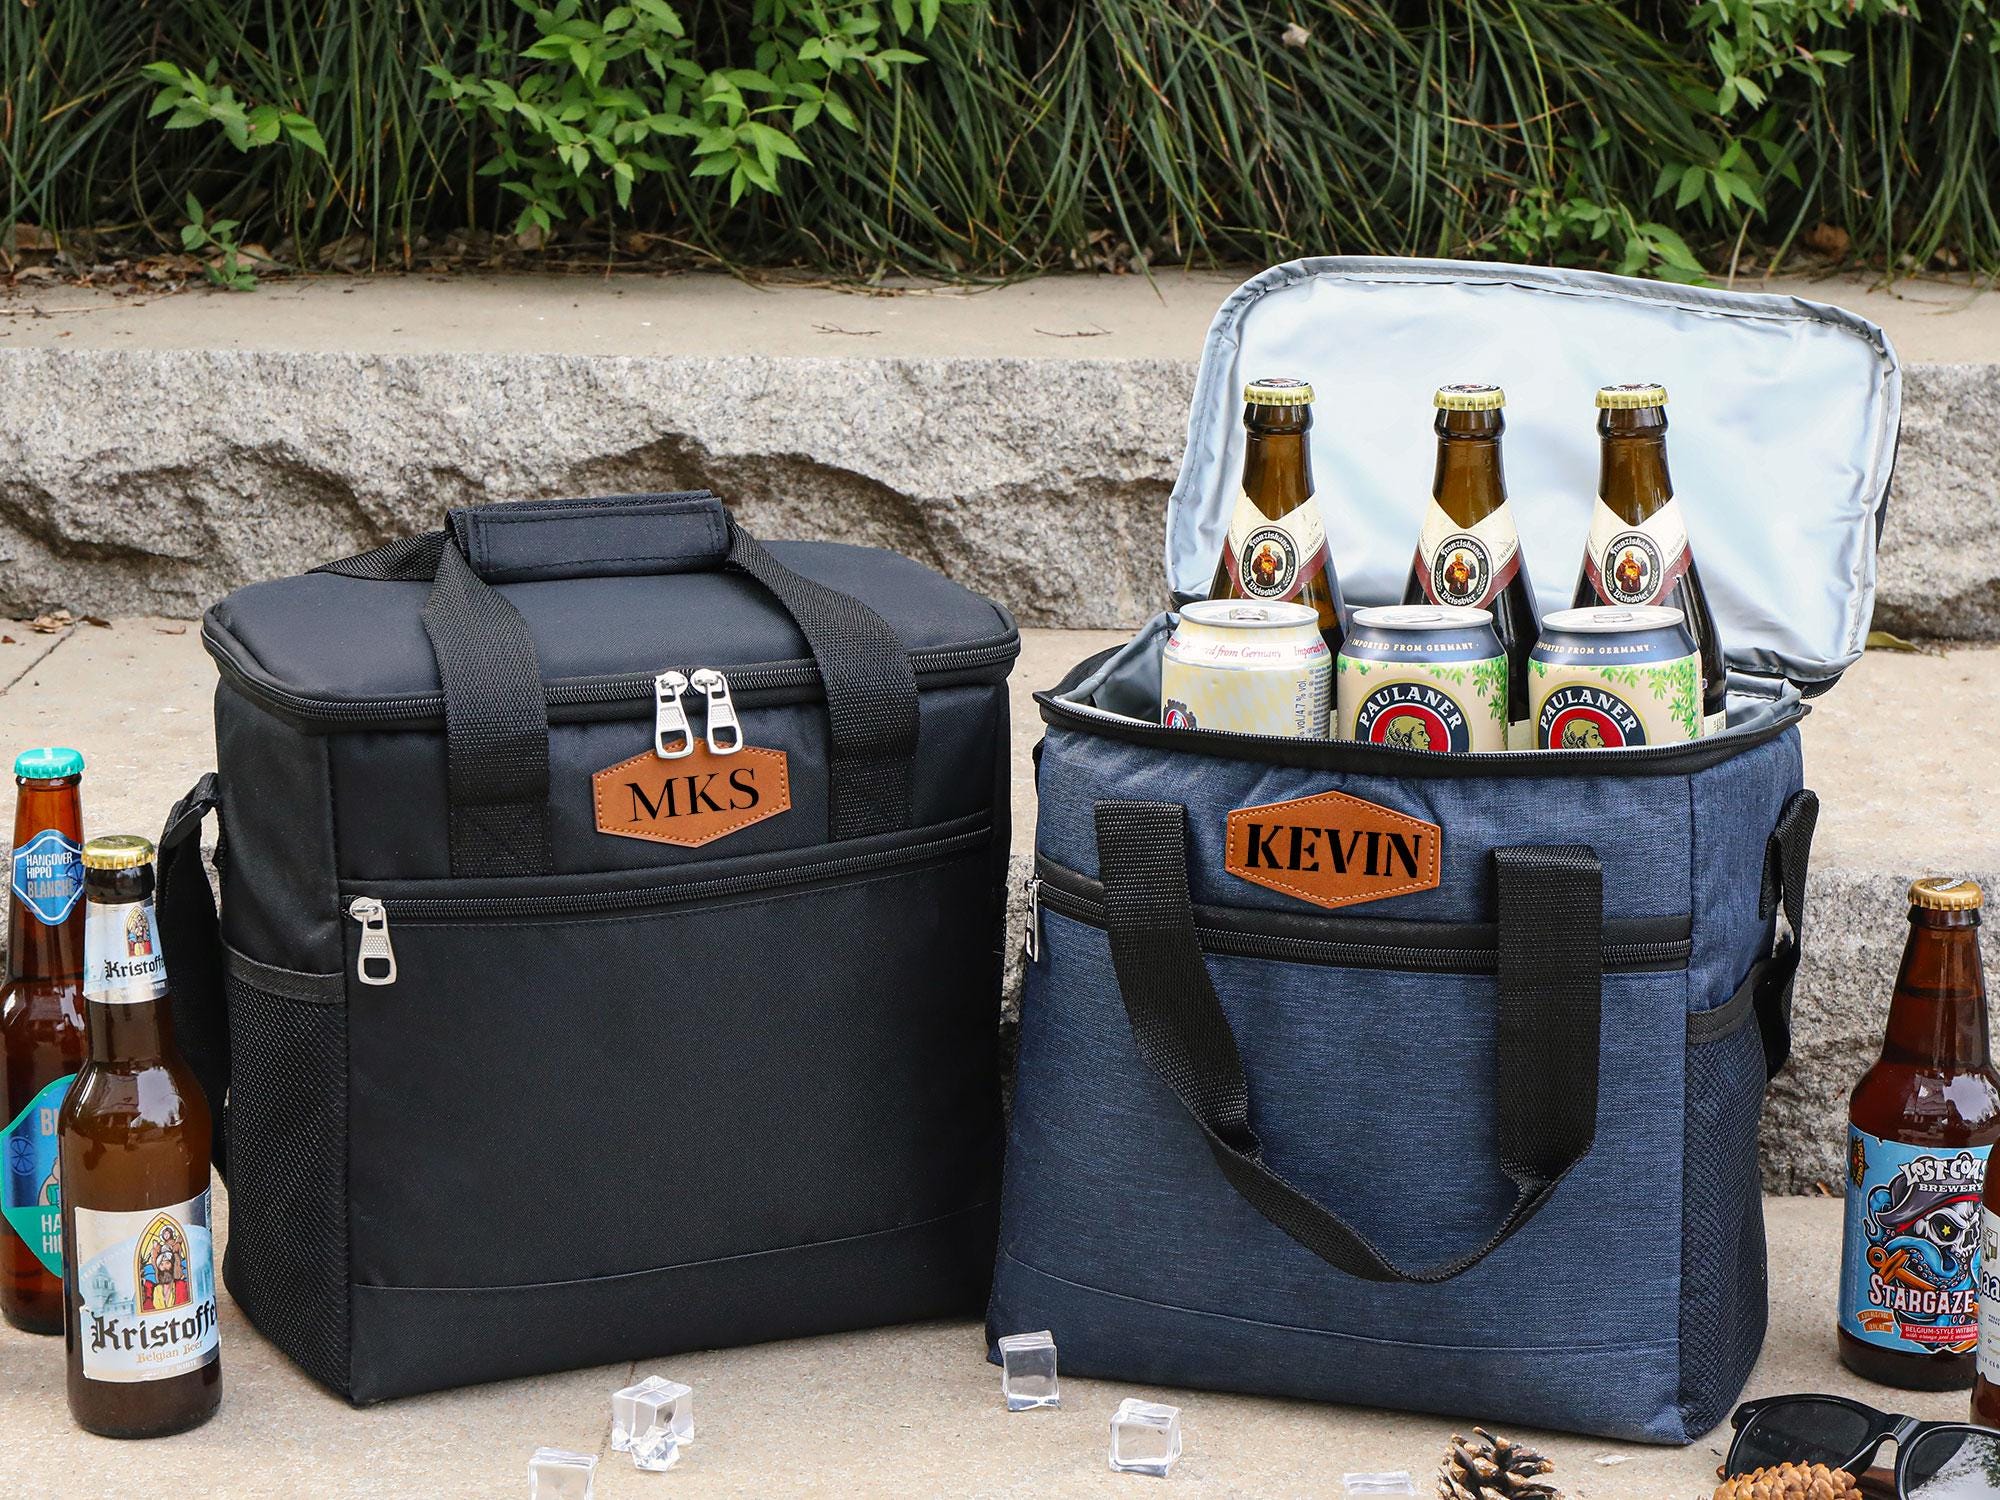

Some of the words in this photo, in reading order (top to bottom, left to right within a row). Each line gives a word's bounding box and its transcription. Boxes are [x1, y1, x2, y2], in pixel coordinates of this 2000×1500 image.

[1440, 540, 1485, 559] Franziskaner
[1610, 536, 1655, 556] Franziskaner
[1248, 581, 1283, 596] Weissbier
[1613, 590, 1649, 603] Weissbier
[1441, 589, 1476, 605] Weissbier
[1213, 645, 1238, 659] from
[1351, 639, 1389, 651] IMPORTED
[1394, 644, 1422, 652] FROM
[1426, 643, 1473, 652] GERMANY
[1567, 646, 1595, 655] FROM
[1599, 644, 1650, 655] GERMANY
[1359, 686, 1462, 730] PAULANER
[1540, 689, 1637, 733] PAULANER
[624, 768, 760, 823] MKS
[1244, 823, 1422, 879] KEVIN
[26, 852, 73, 867] HANGOVER
[26, 866, 52, 879] HIPPO
[104, 954, 165, 981] Kristoff
[1950, 1155, 1987, 1181] COA
[1918, 1183, 1983, 1193] BREWERY
[1905, 1326, 1954, 1335] BELGIUM-STYLE
[136, 1349, 179, 1364] Belgian
[183, 1340, 203, 1355] Beer
